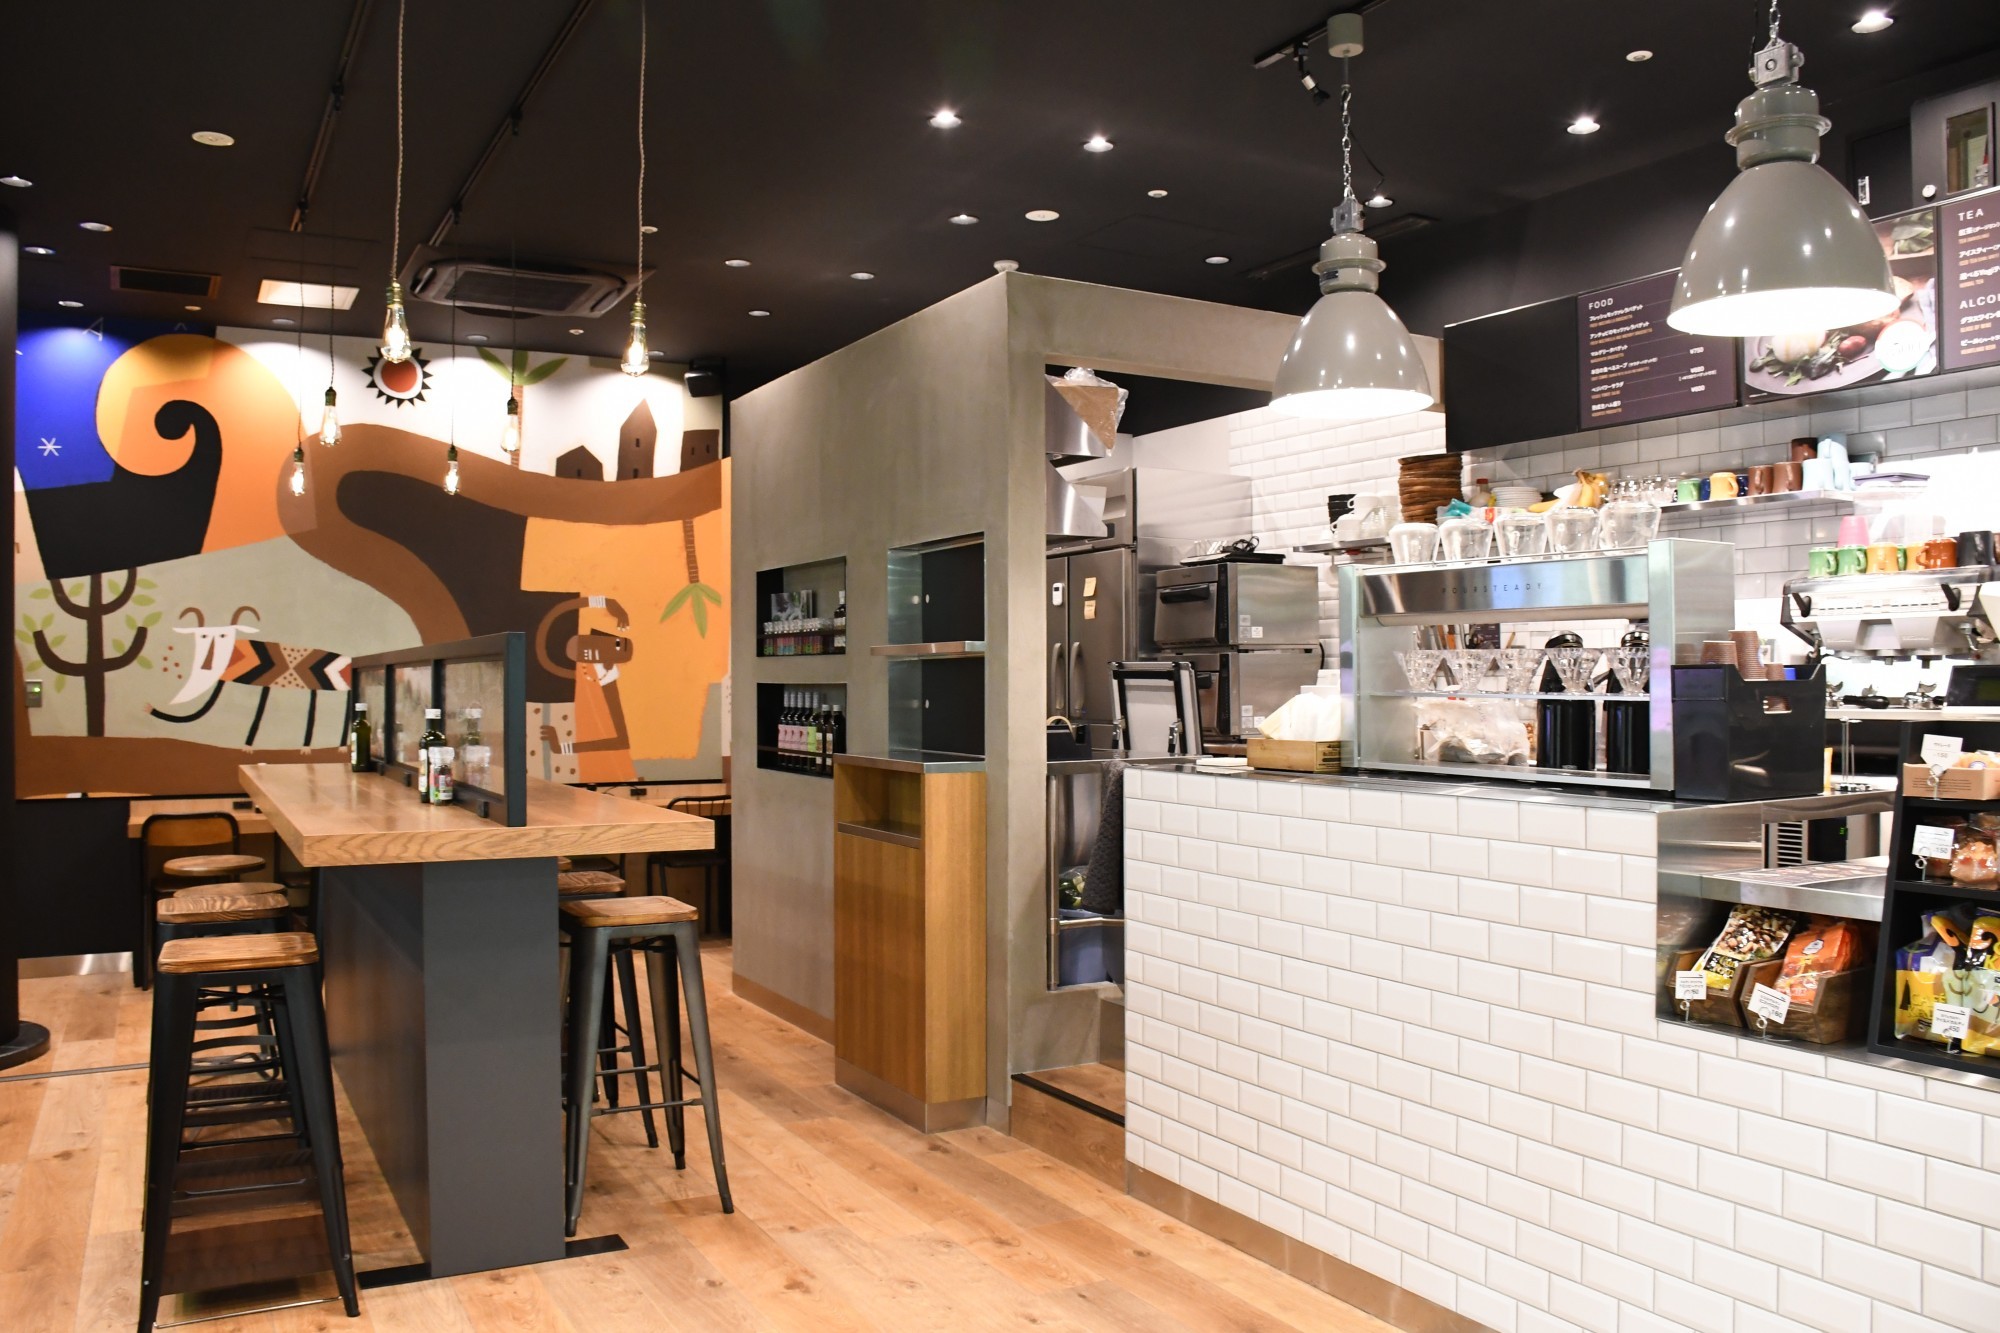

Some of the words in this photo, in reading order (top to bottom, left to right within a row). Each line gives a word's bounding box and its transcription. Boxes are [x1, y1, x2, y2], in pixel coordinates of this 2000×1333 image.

[1958, 208, 1984, 221] TEA
[1588, 298, 1614, 310] FOOD
[1959, 293, 2000, 309] ALCO
[1441, 583, 1542, 594] POURSTEADY
